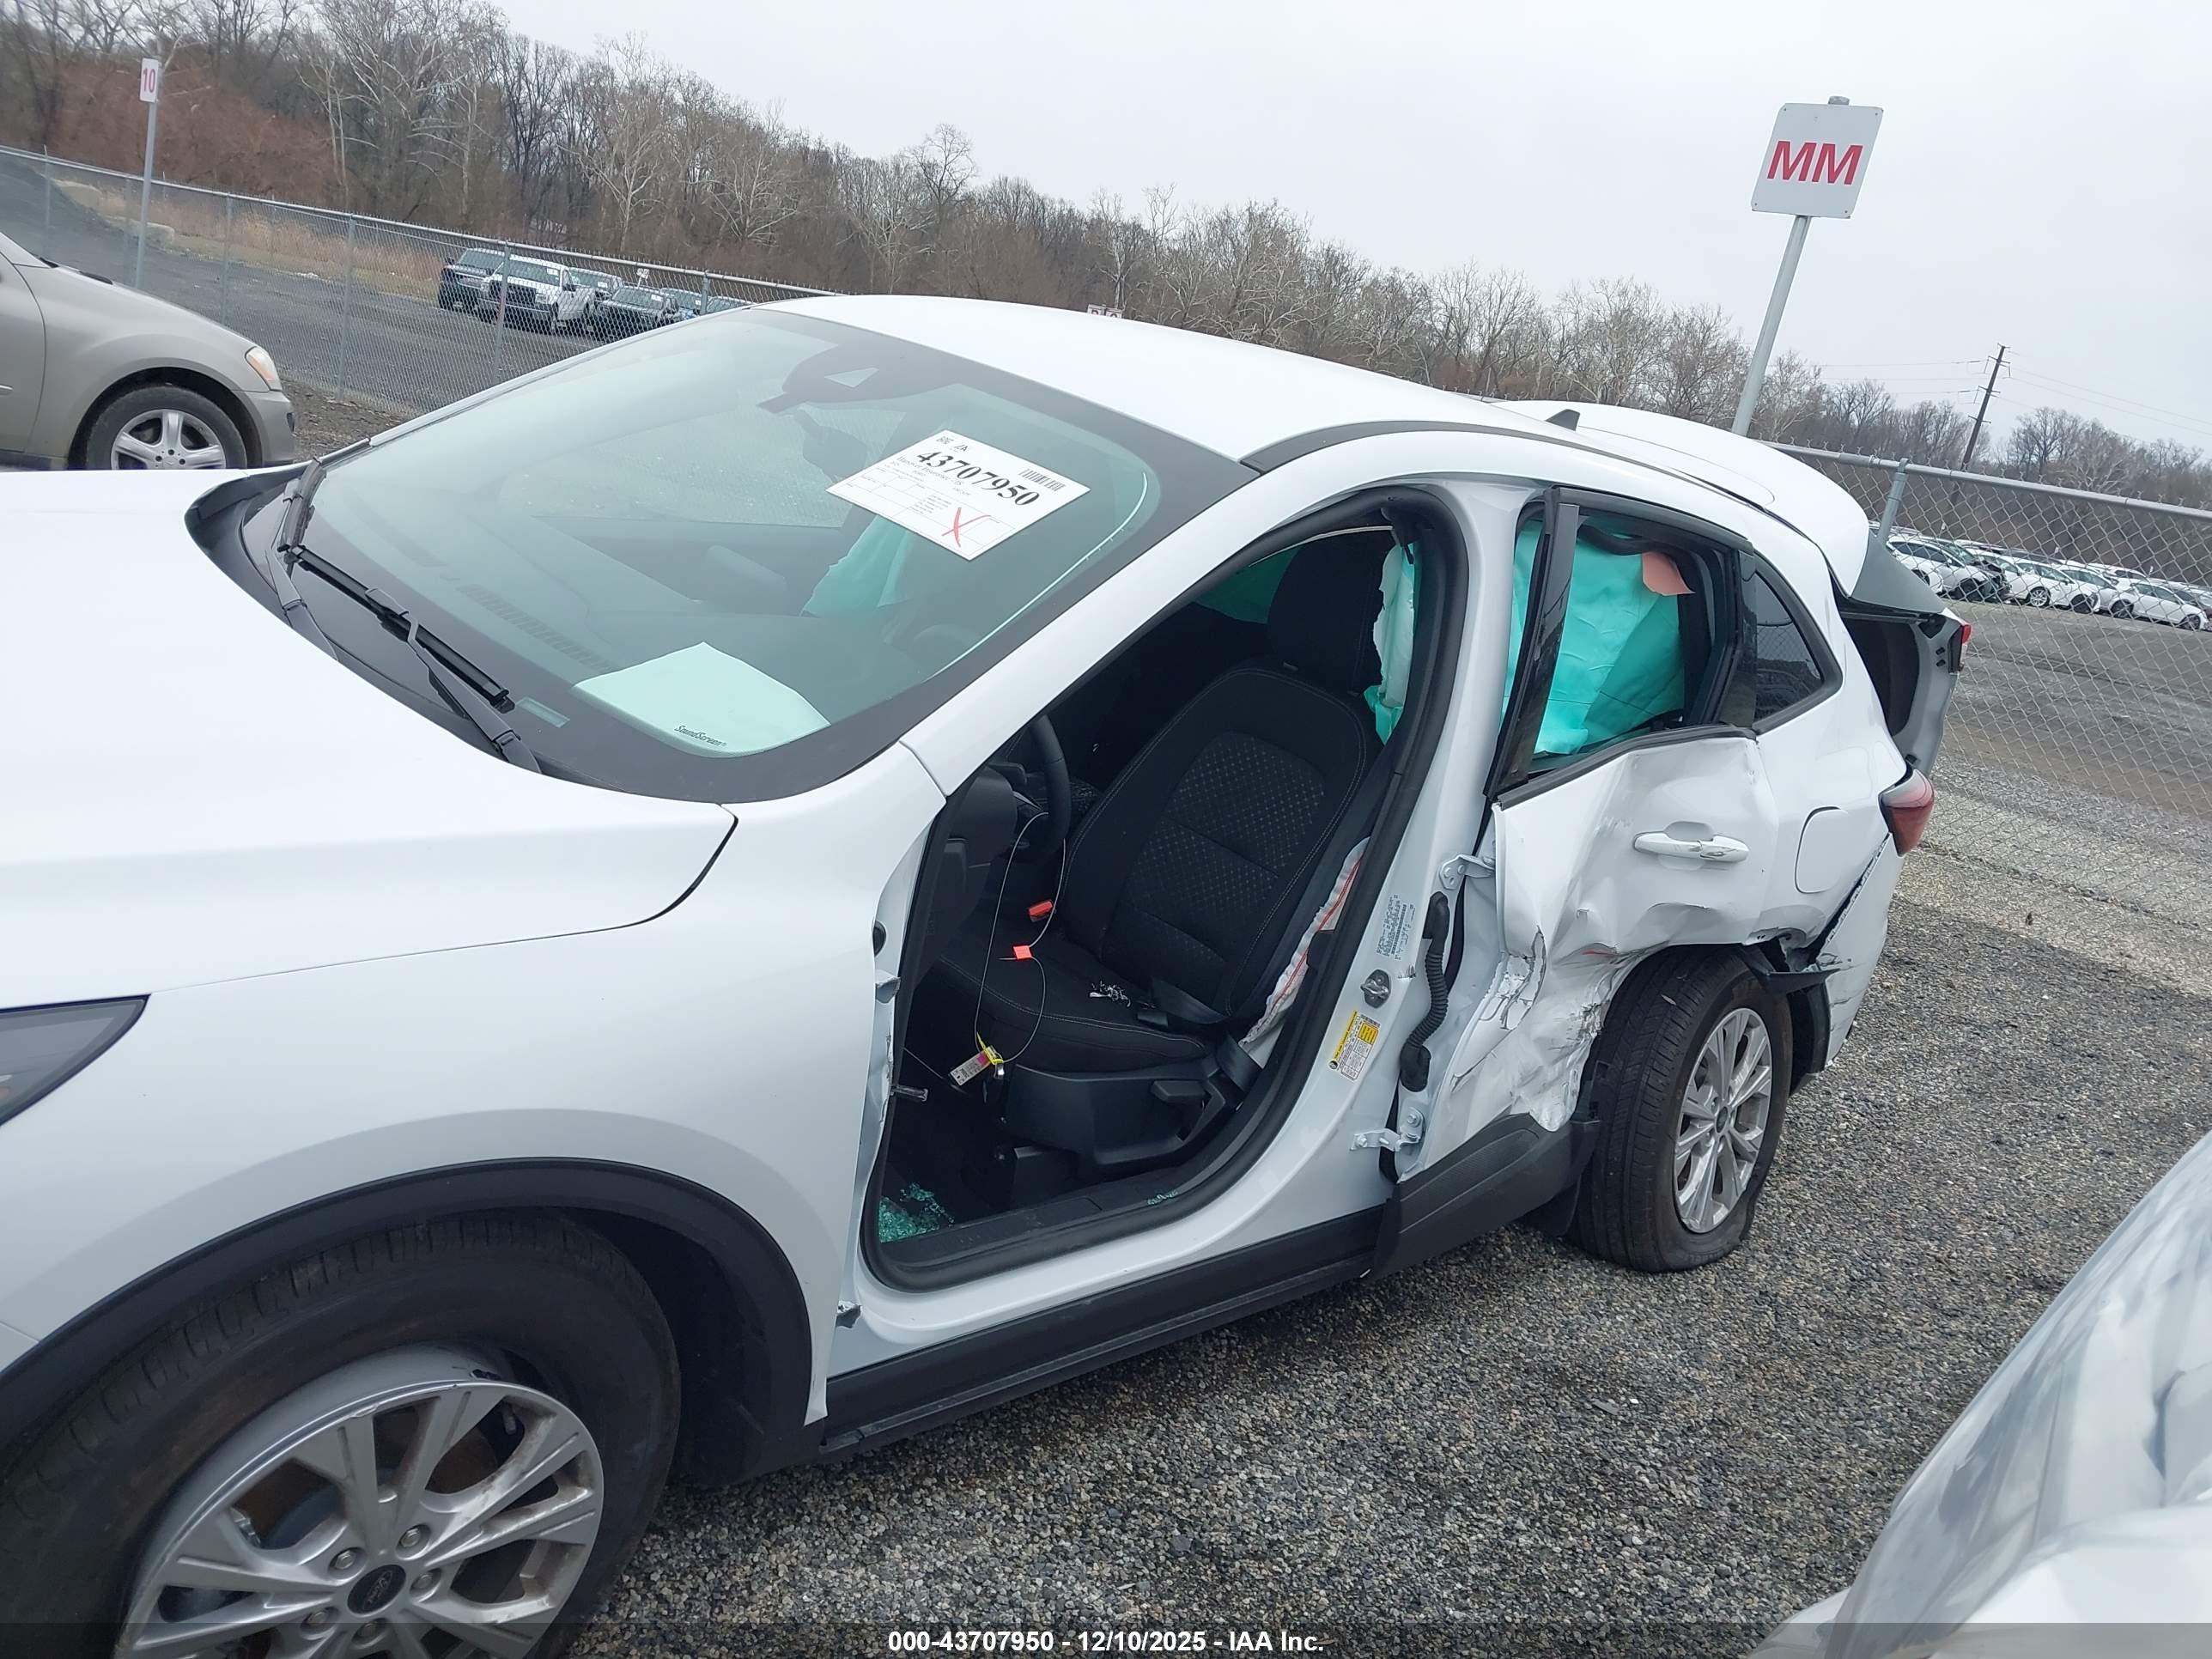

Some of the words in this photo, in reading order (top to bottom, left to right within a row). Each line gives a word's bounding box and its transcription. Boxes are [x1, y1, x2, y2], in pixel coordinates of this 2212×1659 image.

[143, 68, 156, 94] 10
[1766, 140, 1863, 185] MM
[917, 452, 1040, 506] 43707950
